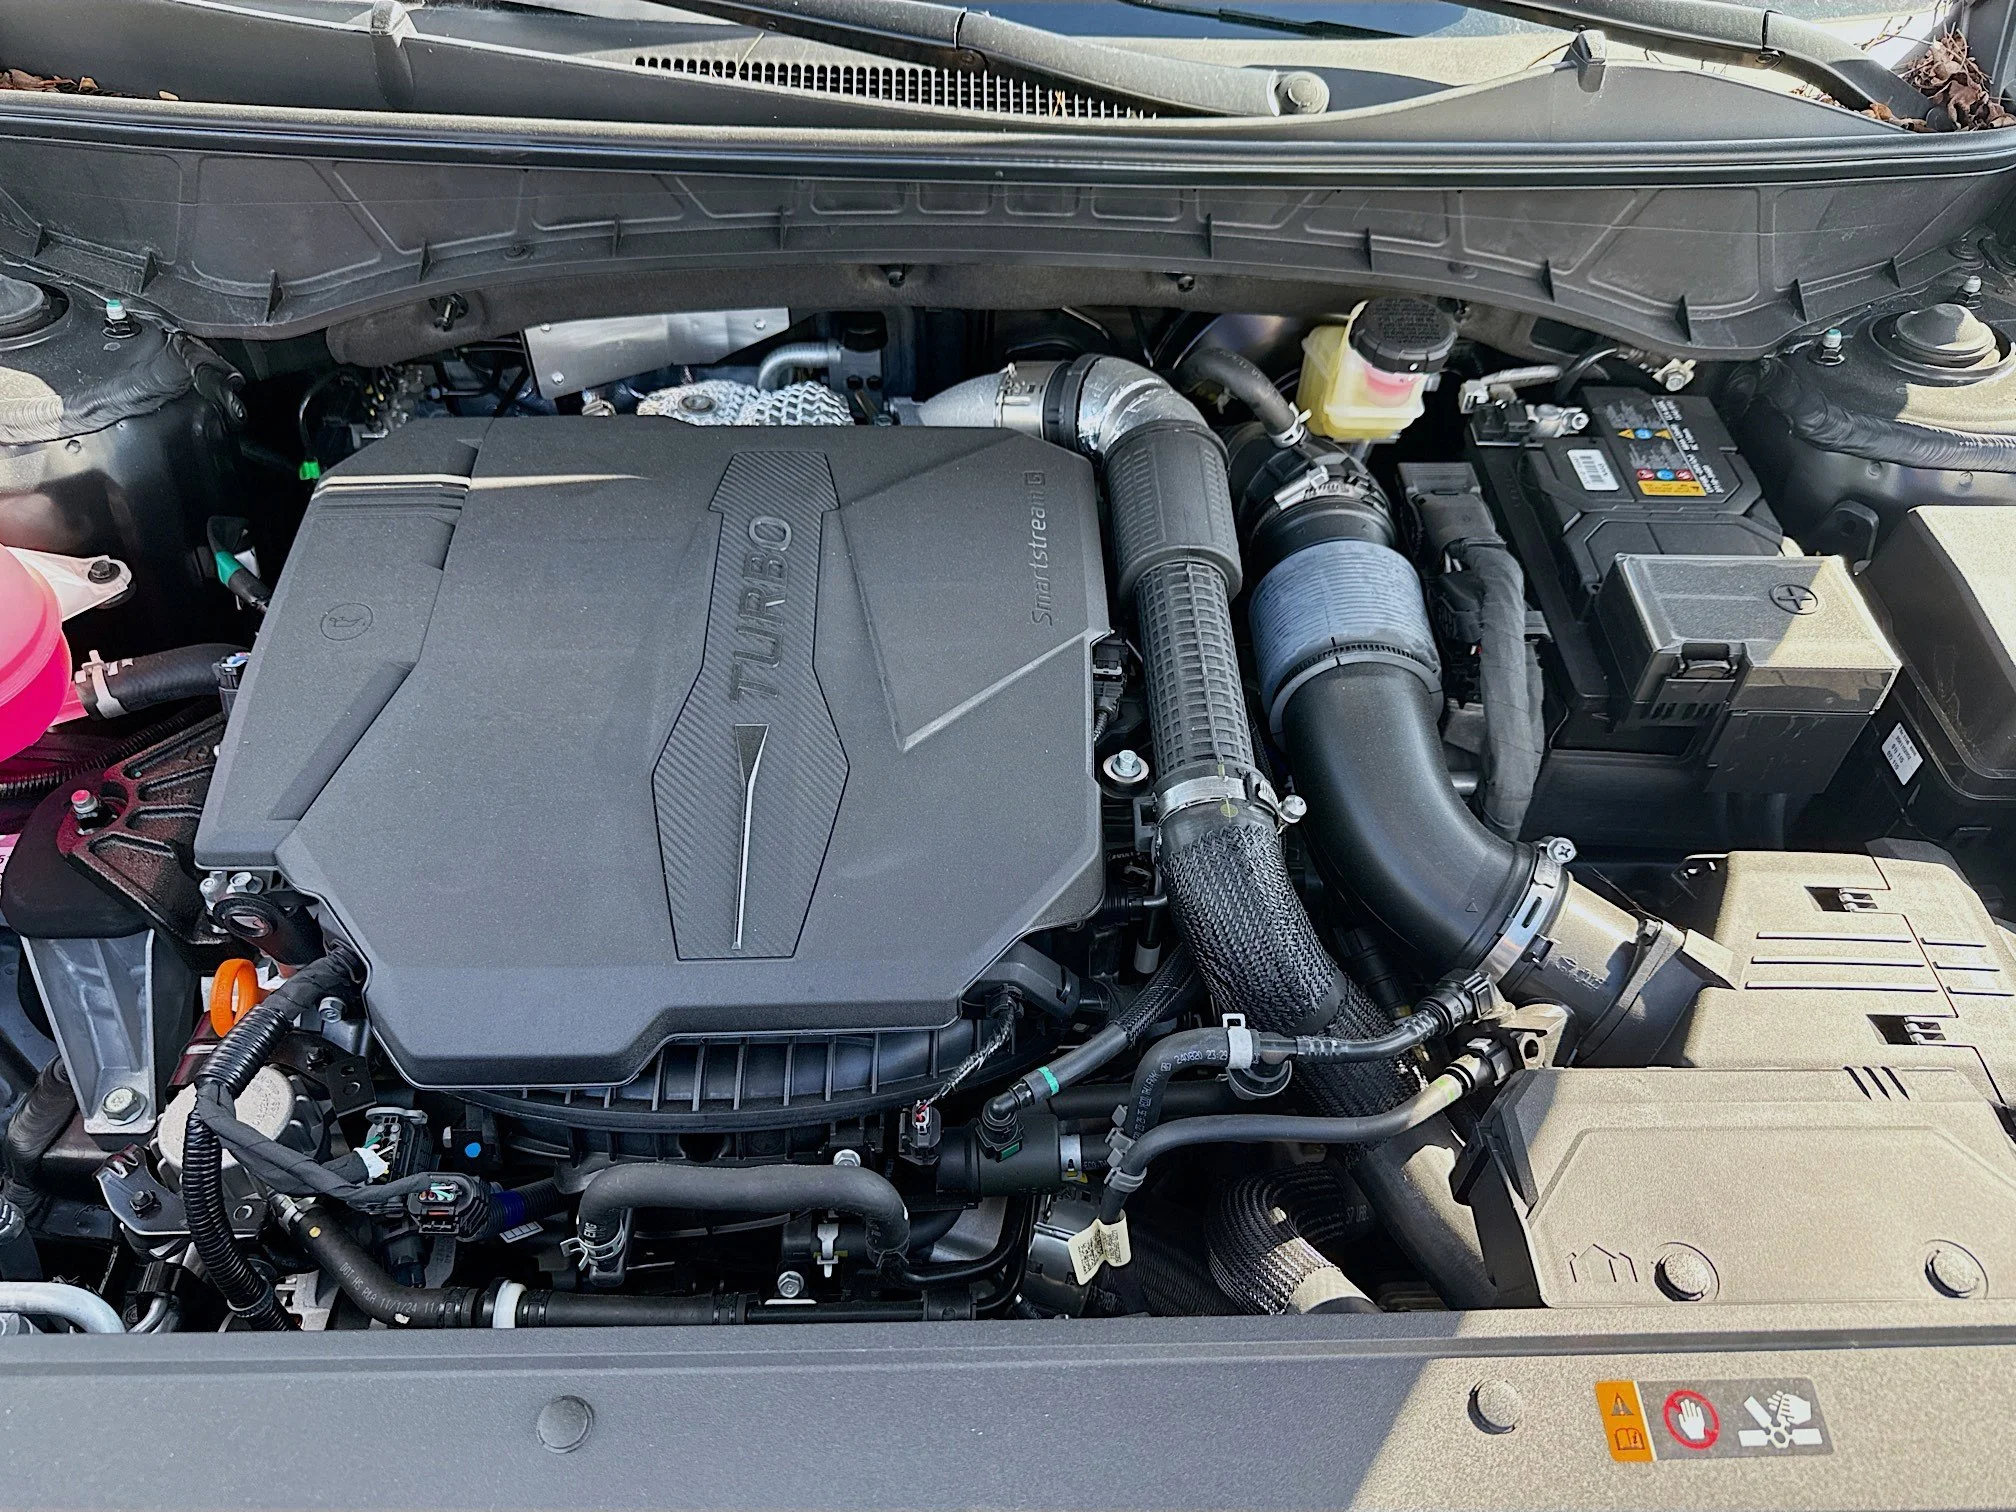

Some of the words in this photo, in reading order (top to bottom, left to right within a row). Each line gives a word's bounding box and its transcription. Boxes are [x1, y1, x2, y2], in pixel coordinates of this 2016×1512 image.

[729, 515, 793, 703] TURBO
[1028, 491, 1053, 627] Smartstream
[352, 1276, 364, 1291] HS
